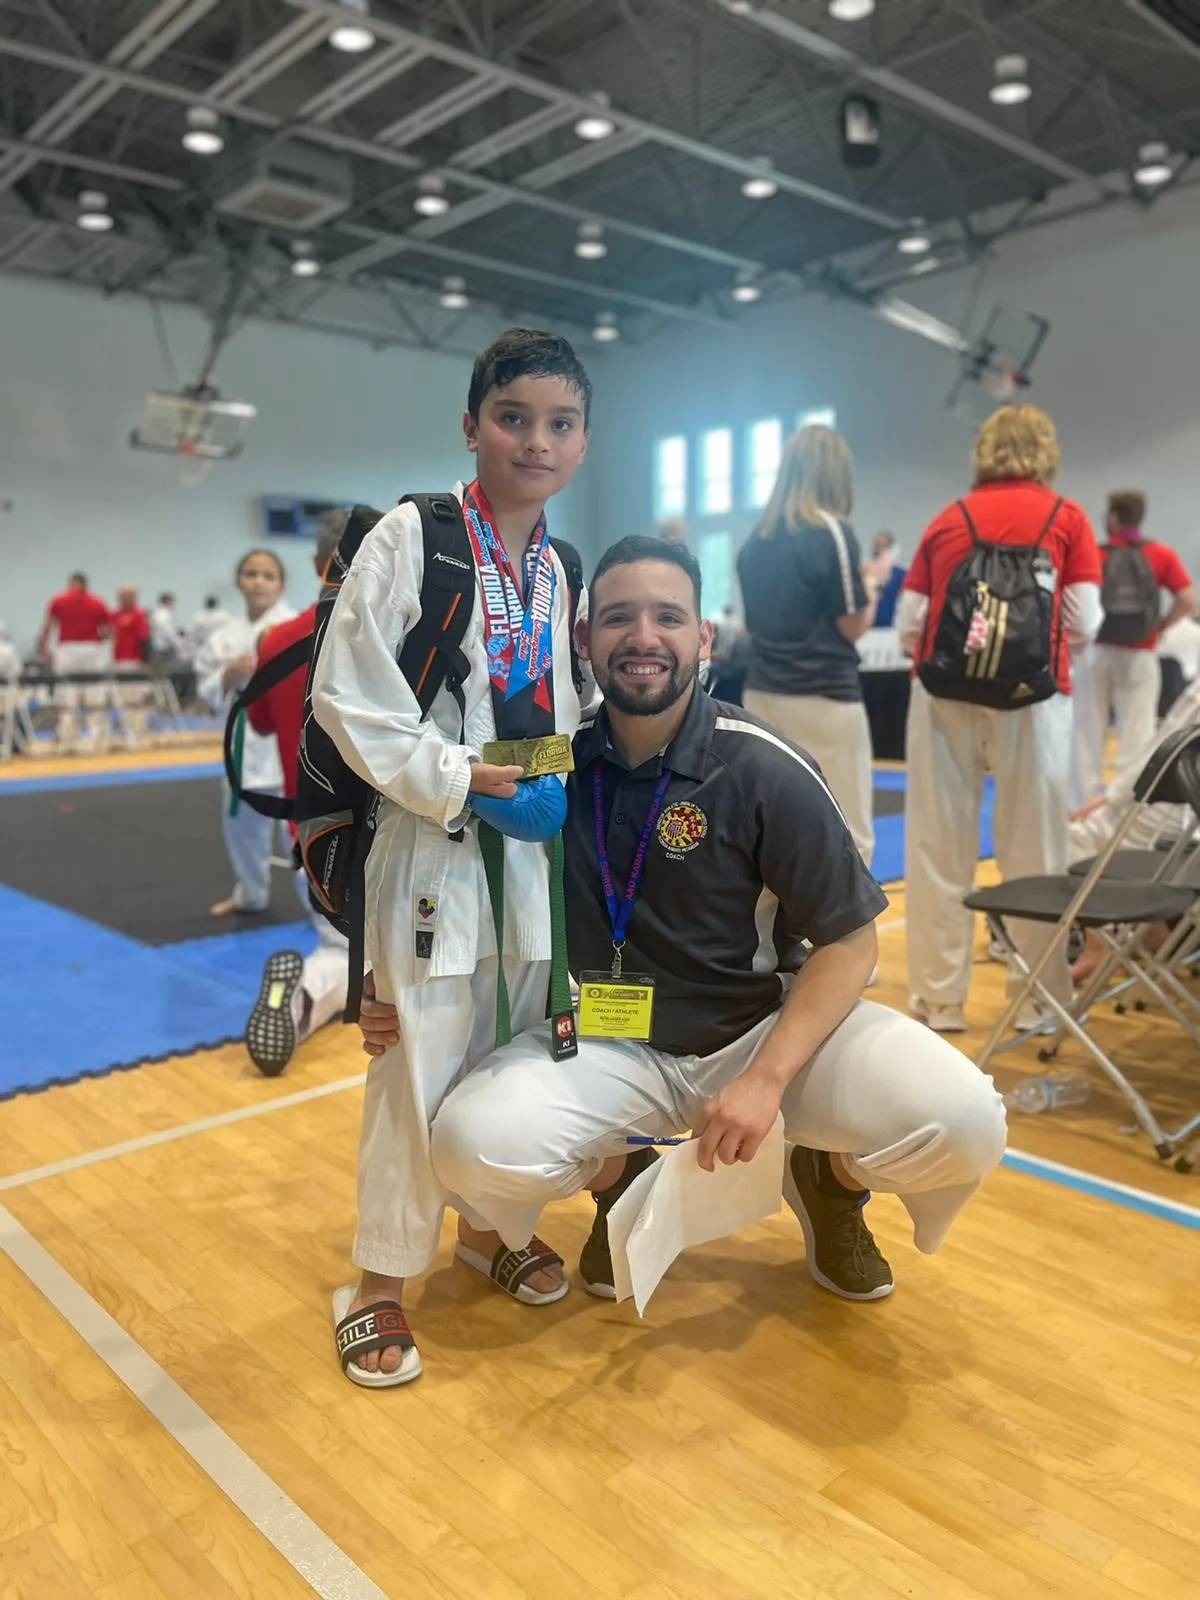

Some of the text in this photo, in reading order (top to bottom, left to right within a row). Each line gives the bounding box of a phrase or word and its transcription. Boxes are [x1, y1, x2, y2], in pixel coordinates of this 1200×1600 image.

[479, 562, 511, 636] FLORIDA
[530, 556, 553, 624] FLORIDA
[625, 880, 636, 903] AAU
[632, 841, 647, 879] KARATE
[665, 852, 685, 860] COACH
